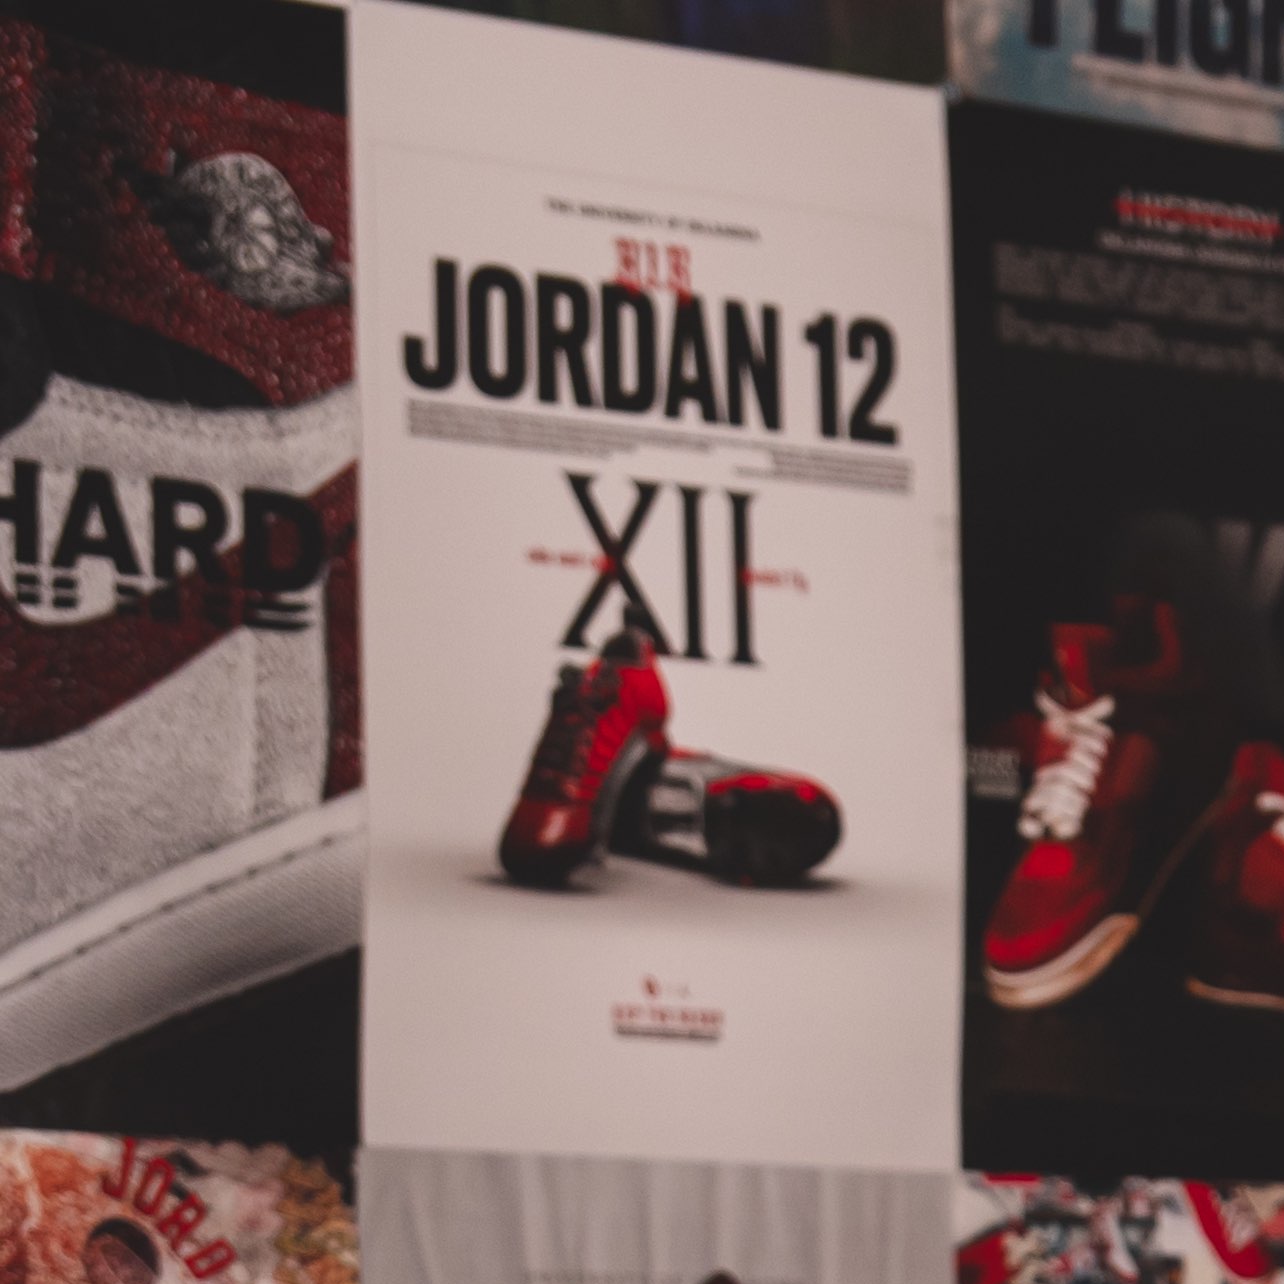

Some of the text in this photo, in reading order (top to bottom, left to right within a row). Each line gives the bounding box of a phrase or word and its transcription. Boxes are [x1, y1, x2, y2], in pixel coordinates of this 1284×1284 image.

[404, 257, 783, 432] JORDAN
[806, 310, 899, 446] 12
[560, 470, 764, 668] XII
